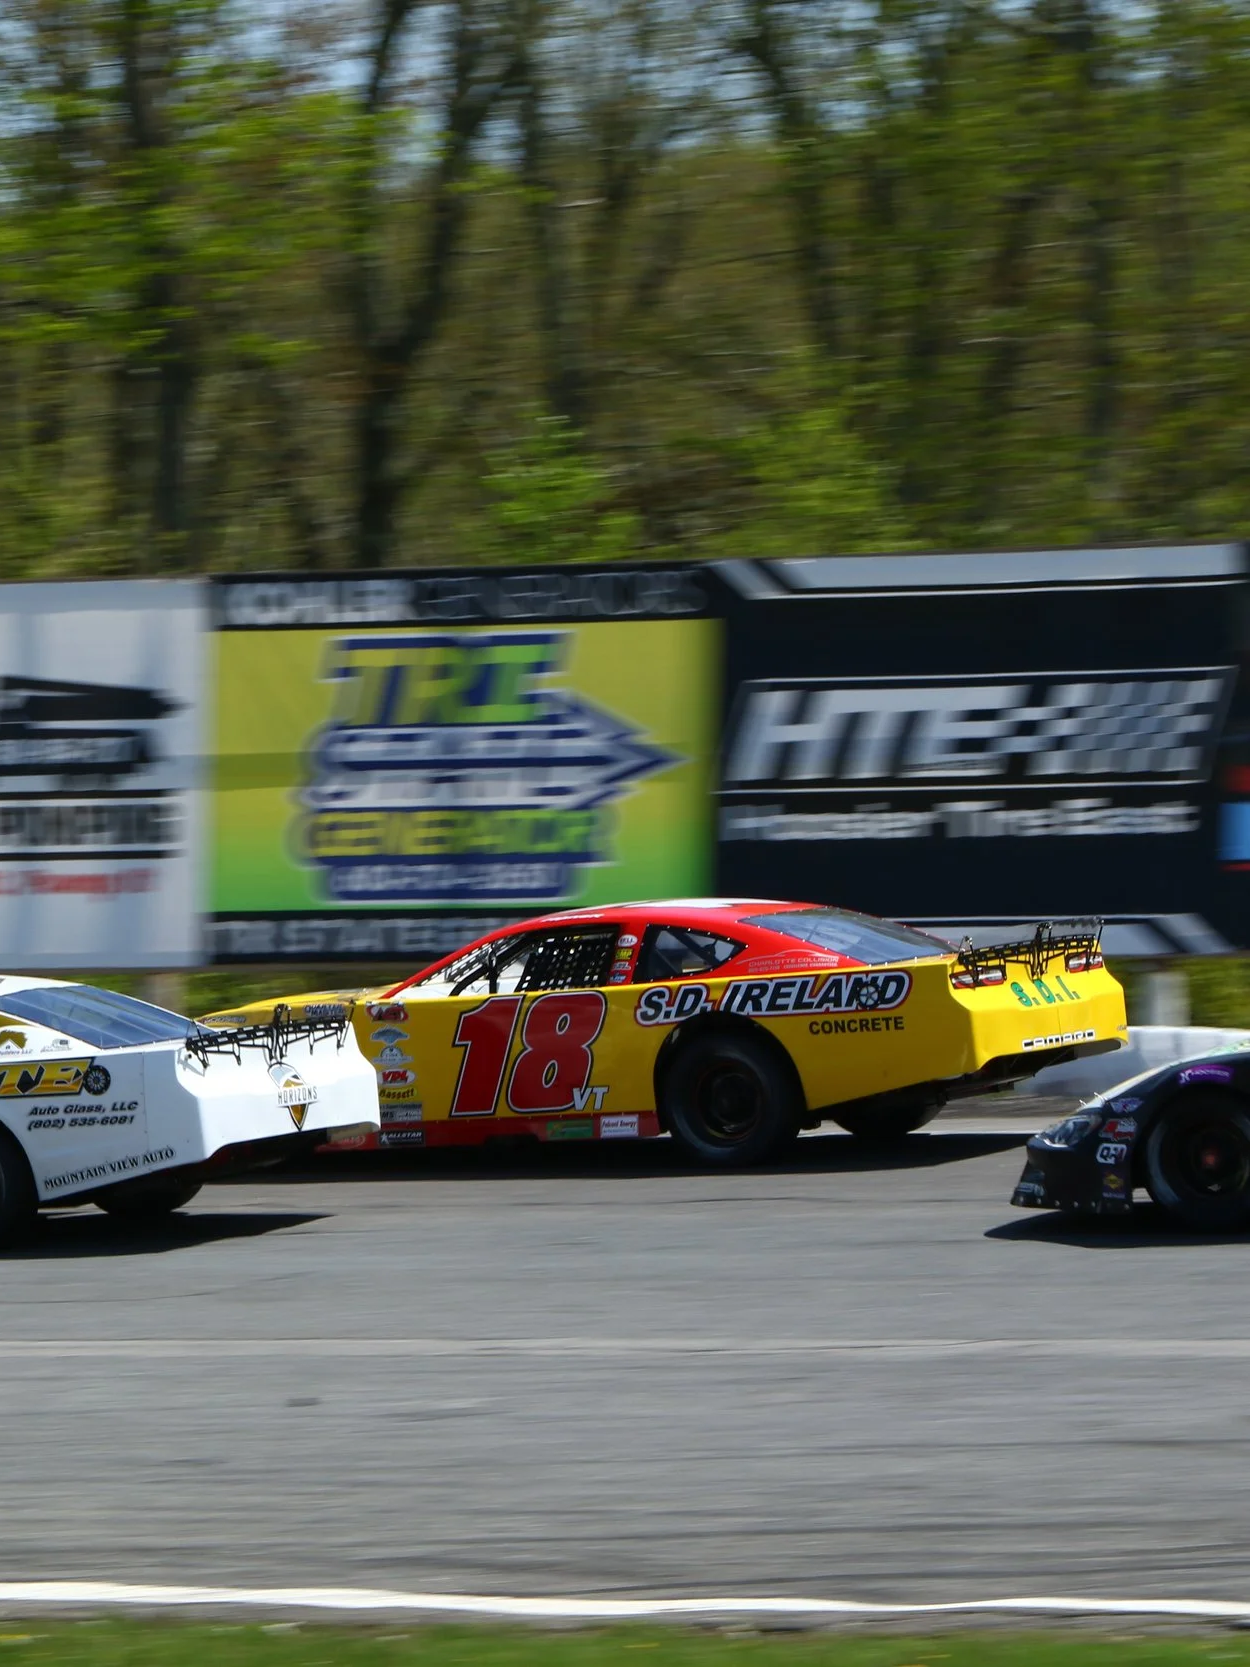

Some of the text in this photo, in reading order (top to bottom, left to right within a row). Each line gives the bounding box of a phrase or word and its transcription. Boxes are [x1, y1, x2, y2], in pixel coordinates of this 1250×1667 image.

[808, 1016, 905, 1035] CONCRETE
[449, 990, 608, 1117] 18
[277, 1086, 318, 1105] HORIZONS
[572, 1087, 609, 1111] VT
[29, 1101, 139, 1116] Auto Glass, LLC
[27, 1115, 135, 1131] (802) 535-6081
[388, 1131, 422, 1139] ALLSTAR
[44, 1147, 176, 1190] MOUNTAIN VIEW AUTO
